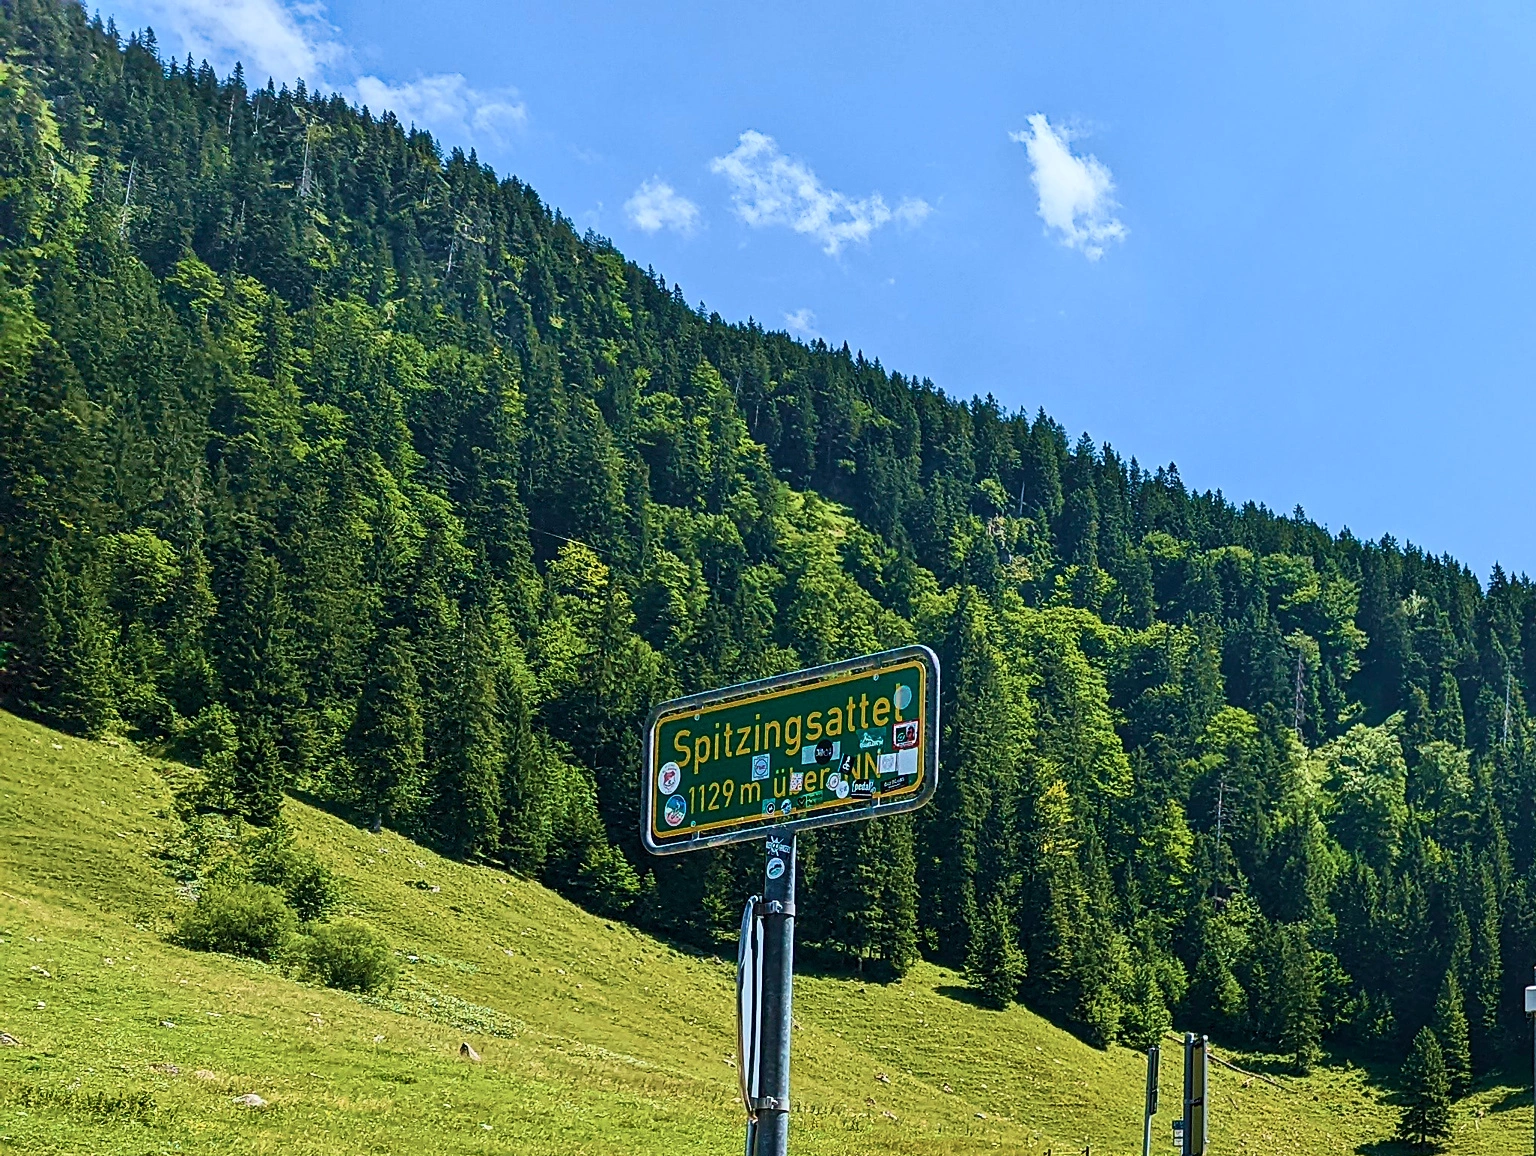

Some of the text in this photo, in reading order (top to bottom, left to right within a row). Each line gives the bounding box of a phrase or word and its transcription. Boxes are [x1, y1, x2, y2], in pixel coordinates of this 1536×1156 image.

[674, 683, 902, 775] Spitzingsattel
[688, 779, 735, 814] 1129
[740, 782, 761, 805] m
